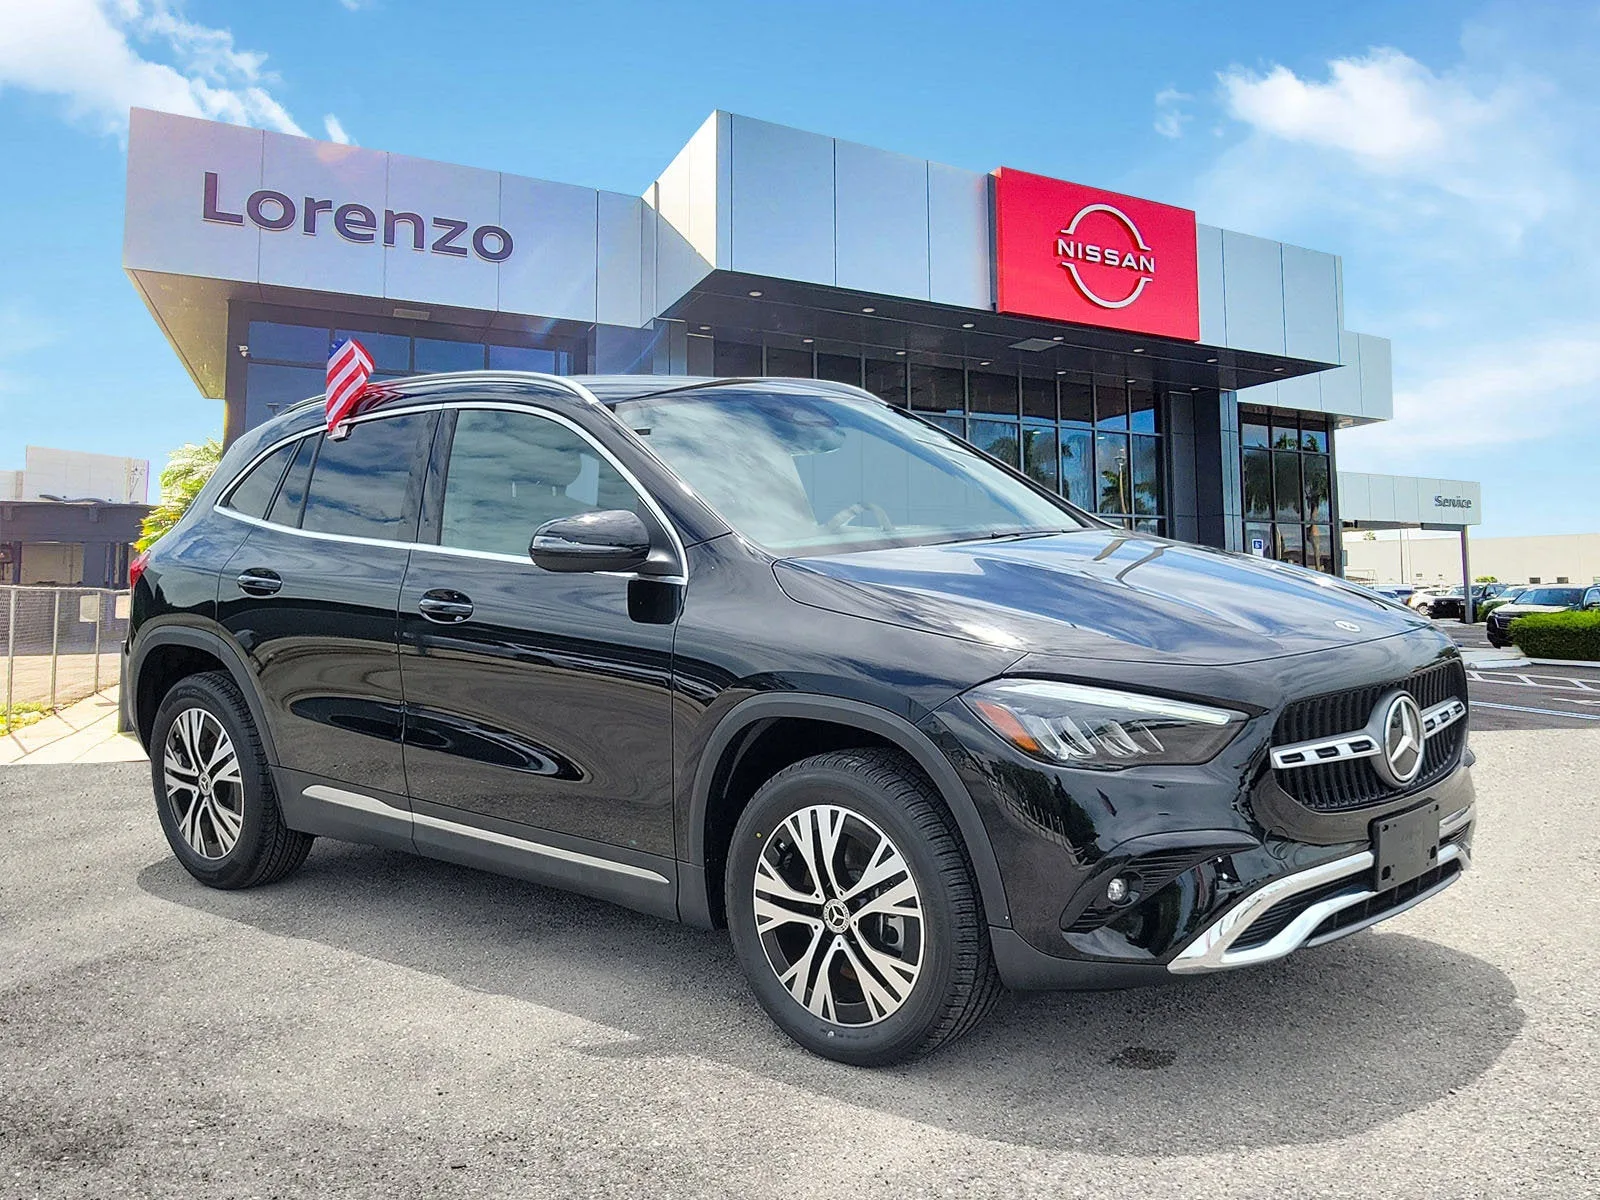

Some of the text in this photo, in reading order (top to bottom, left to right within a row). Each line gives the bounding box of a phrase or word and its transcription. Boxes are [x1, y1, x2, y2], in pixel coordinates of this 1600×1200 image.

[202, 171, 514, 263] Lorenzo
[1058, 239, 1154, 273] NISSAN
[1434, 495, 1472, 508] Service
